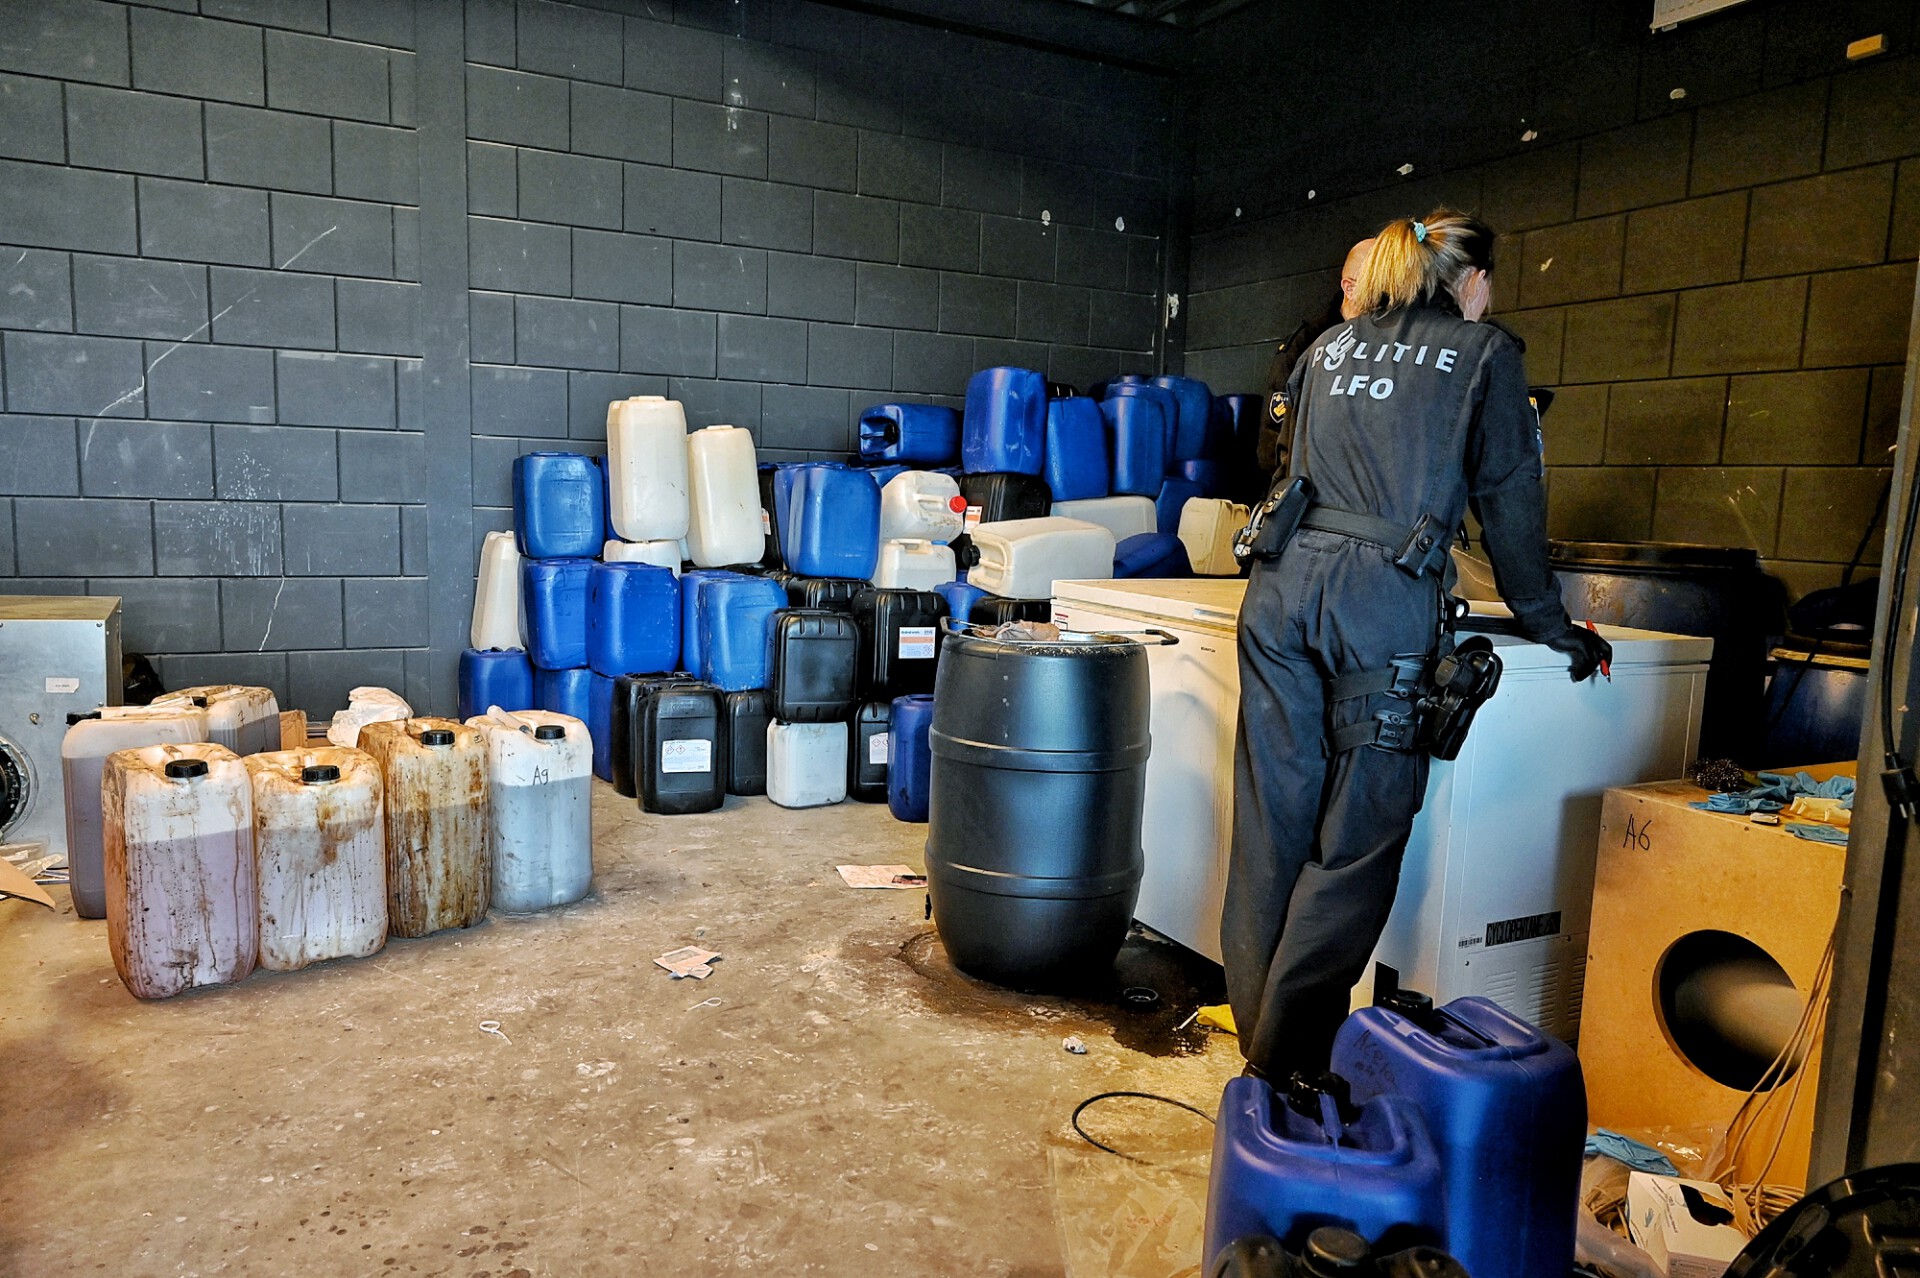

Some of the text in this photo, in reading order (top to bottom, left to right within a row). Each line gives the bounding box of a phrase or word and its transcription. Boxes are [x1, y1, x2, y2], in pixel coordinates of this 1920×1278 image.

[1311, 336, 1458, 373] POLITIE
[1329, 375, 1394, 400] LFO
[1622, 813, 1651, 851] A6
[1485, 915, 1543, 947] CYCLOPENTANE
